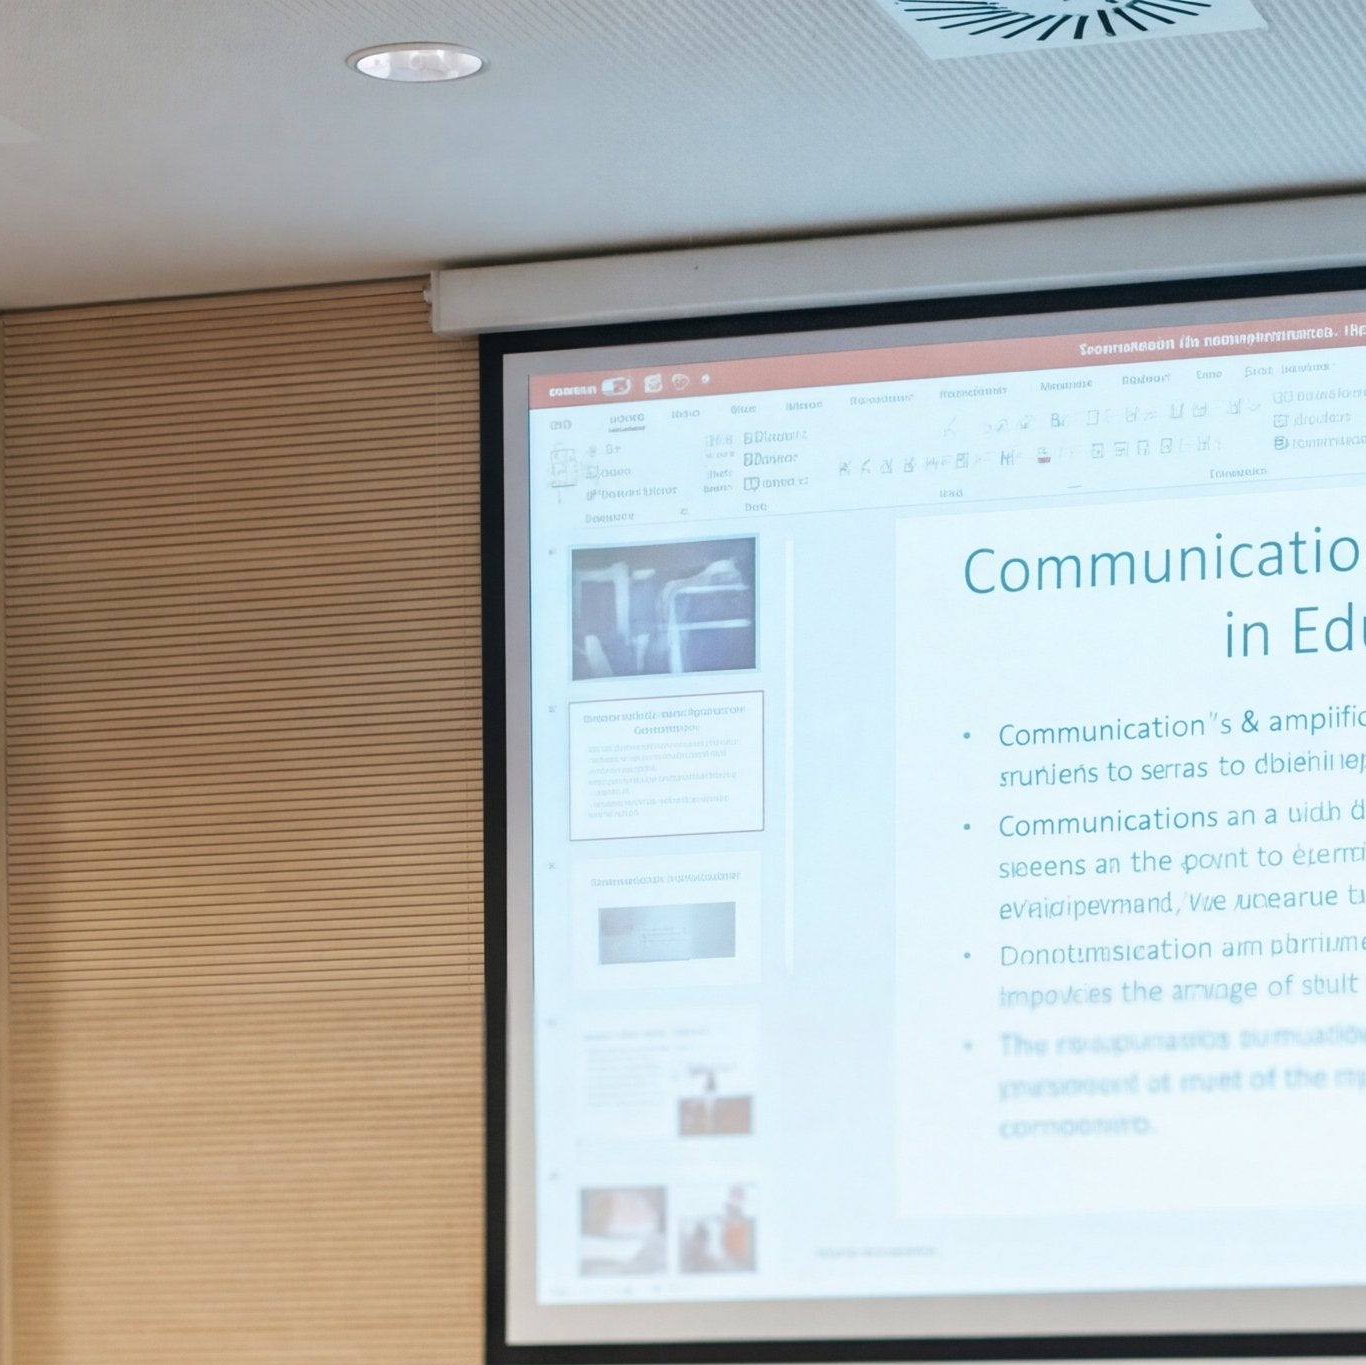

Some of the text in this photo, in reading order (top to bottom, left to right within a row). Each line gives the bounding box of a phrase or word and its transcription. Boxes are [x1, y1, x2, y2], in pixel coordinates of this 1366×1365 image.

[1226, 610, 1269, 658] in
[1241, 710, 1259, 733] &
[1107, 762, 1133, 783] to
[1219, 756, 1245, 776] to
[999, 806, 1218, 837] Communications
[1227, 806, 1255, 826] an
[1265, 808, 1277, 825] a
[1095, 857, 1121, 875] an
[1131, 849, 1173, 873] the
[1258, 846, 1283, 868] to
[1121, 980, 1163, 1002] the
[1268, 974, 1294, 997] of
